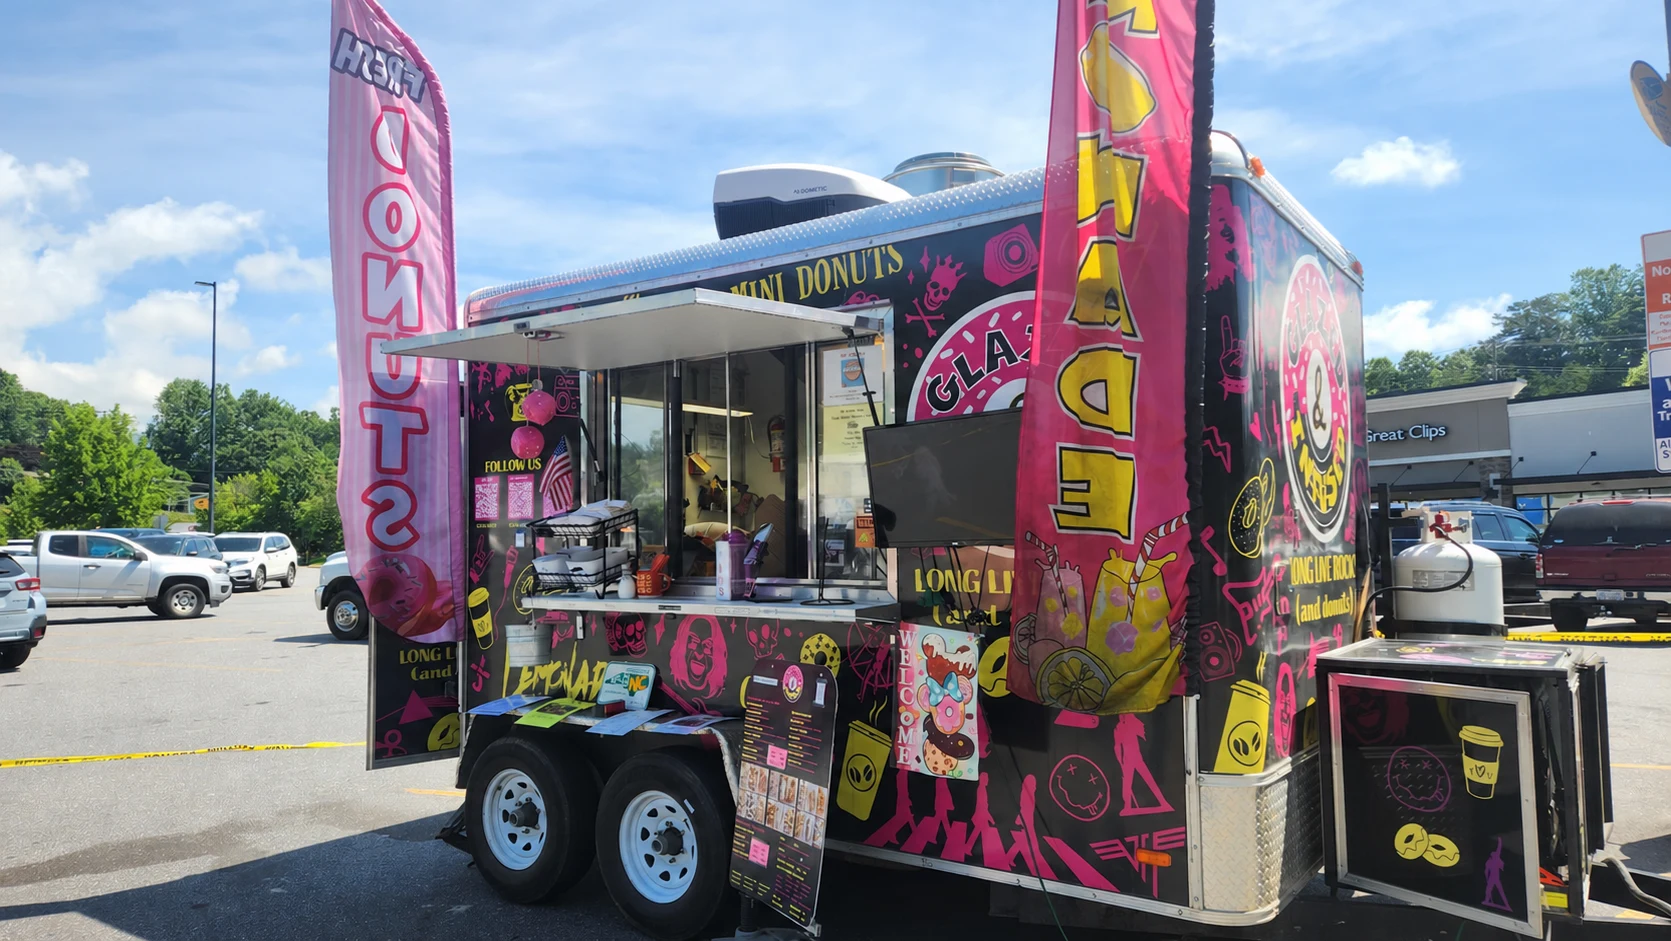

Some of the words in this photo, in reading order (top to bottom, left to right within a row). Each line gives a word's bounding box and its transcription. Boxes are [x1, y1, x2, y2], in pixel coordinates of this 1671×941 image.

[796, 245, 904, 300] DONUTS
[1286, 286, 1345, 389] GLAZED
[1367, 429, 1405, 442] Great
[1408, 423, 1446, 441] Clips
[485, 458, 526, 473] FOLLOW
[527, 458, 542, 470] US
[915, 568, 980, 593] LONG
[987, 569, 1015, 594] LI
[1289, 555, 1314, 586] LONG
[1315, 554, 1333, 584] LIVE
[1295, 593, 1321, 627] (and
[1322, 586, 1354, 618] donuts)
[399, 647, 441, 665] LONG
[445, 646, 456, 660] L
[410, 664, 452, 681] (and
[502, 640, 608, 701] LEMONAD
[629, 675, 649, 692] NC
[897, 629, 917, 764] WELCOME
